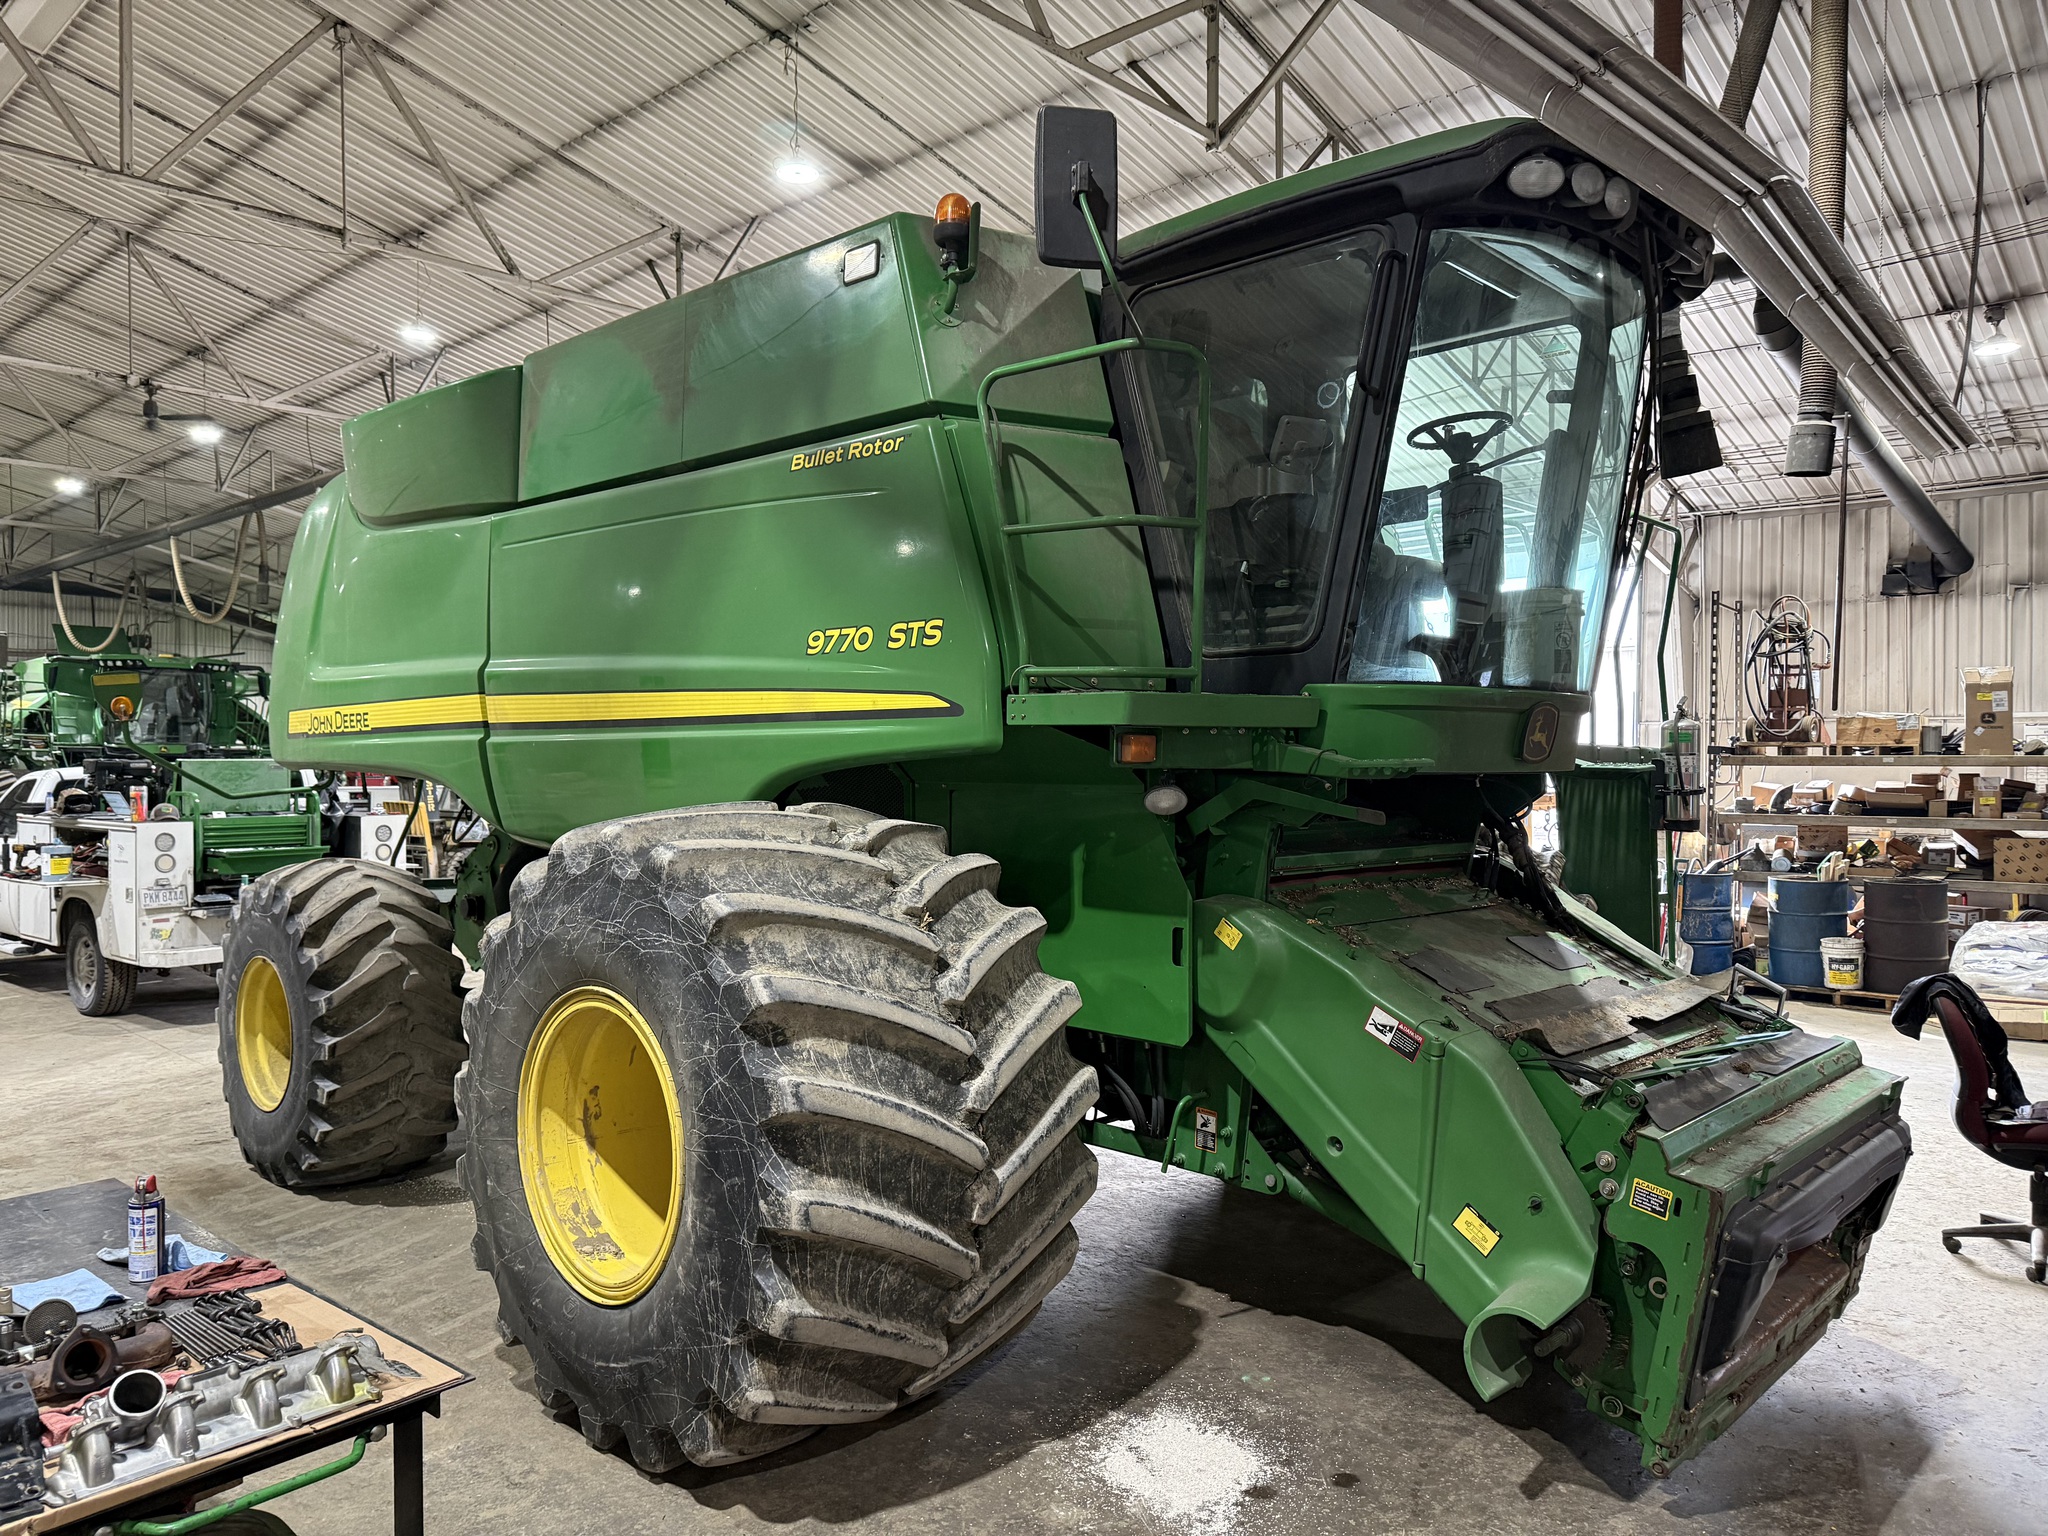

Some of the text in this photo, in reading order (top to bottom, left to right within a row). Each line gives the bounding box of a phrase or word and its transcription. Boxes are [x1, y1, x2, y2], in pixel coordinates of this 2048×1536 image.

[790, 436, 905, 472] Bullet Rotor
[806, 618, 945, 655] 9770 STS
[308, 711, 370, 732] JOHN DEERE
[1640, 1181, 1672, 1198] CAUTION
